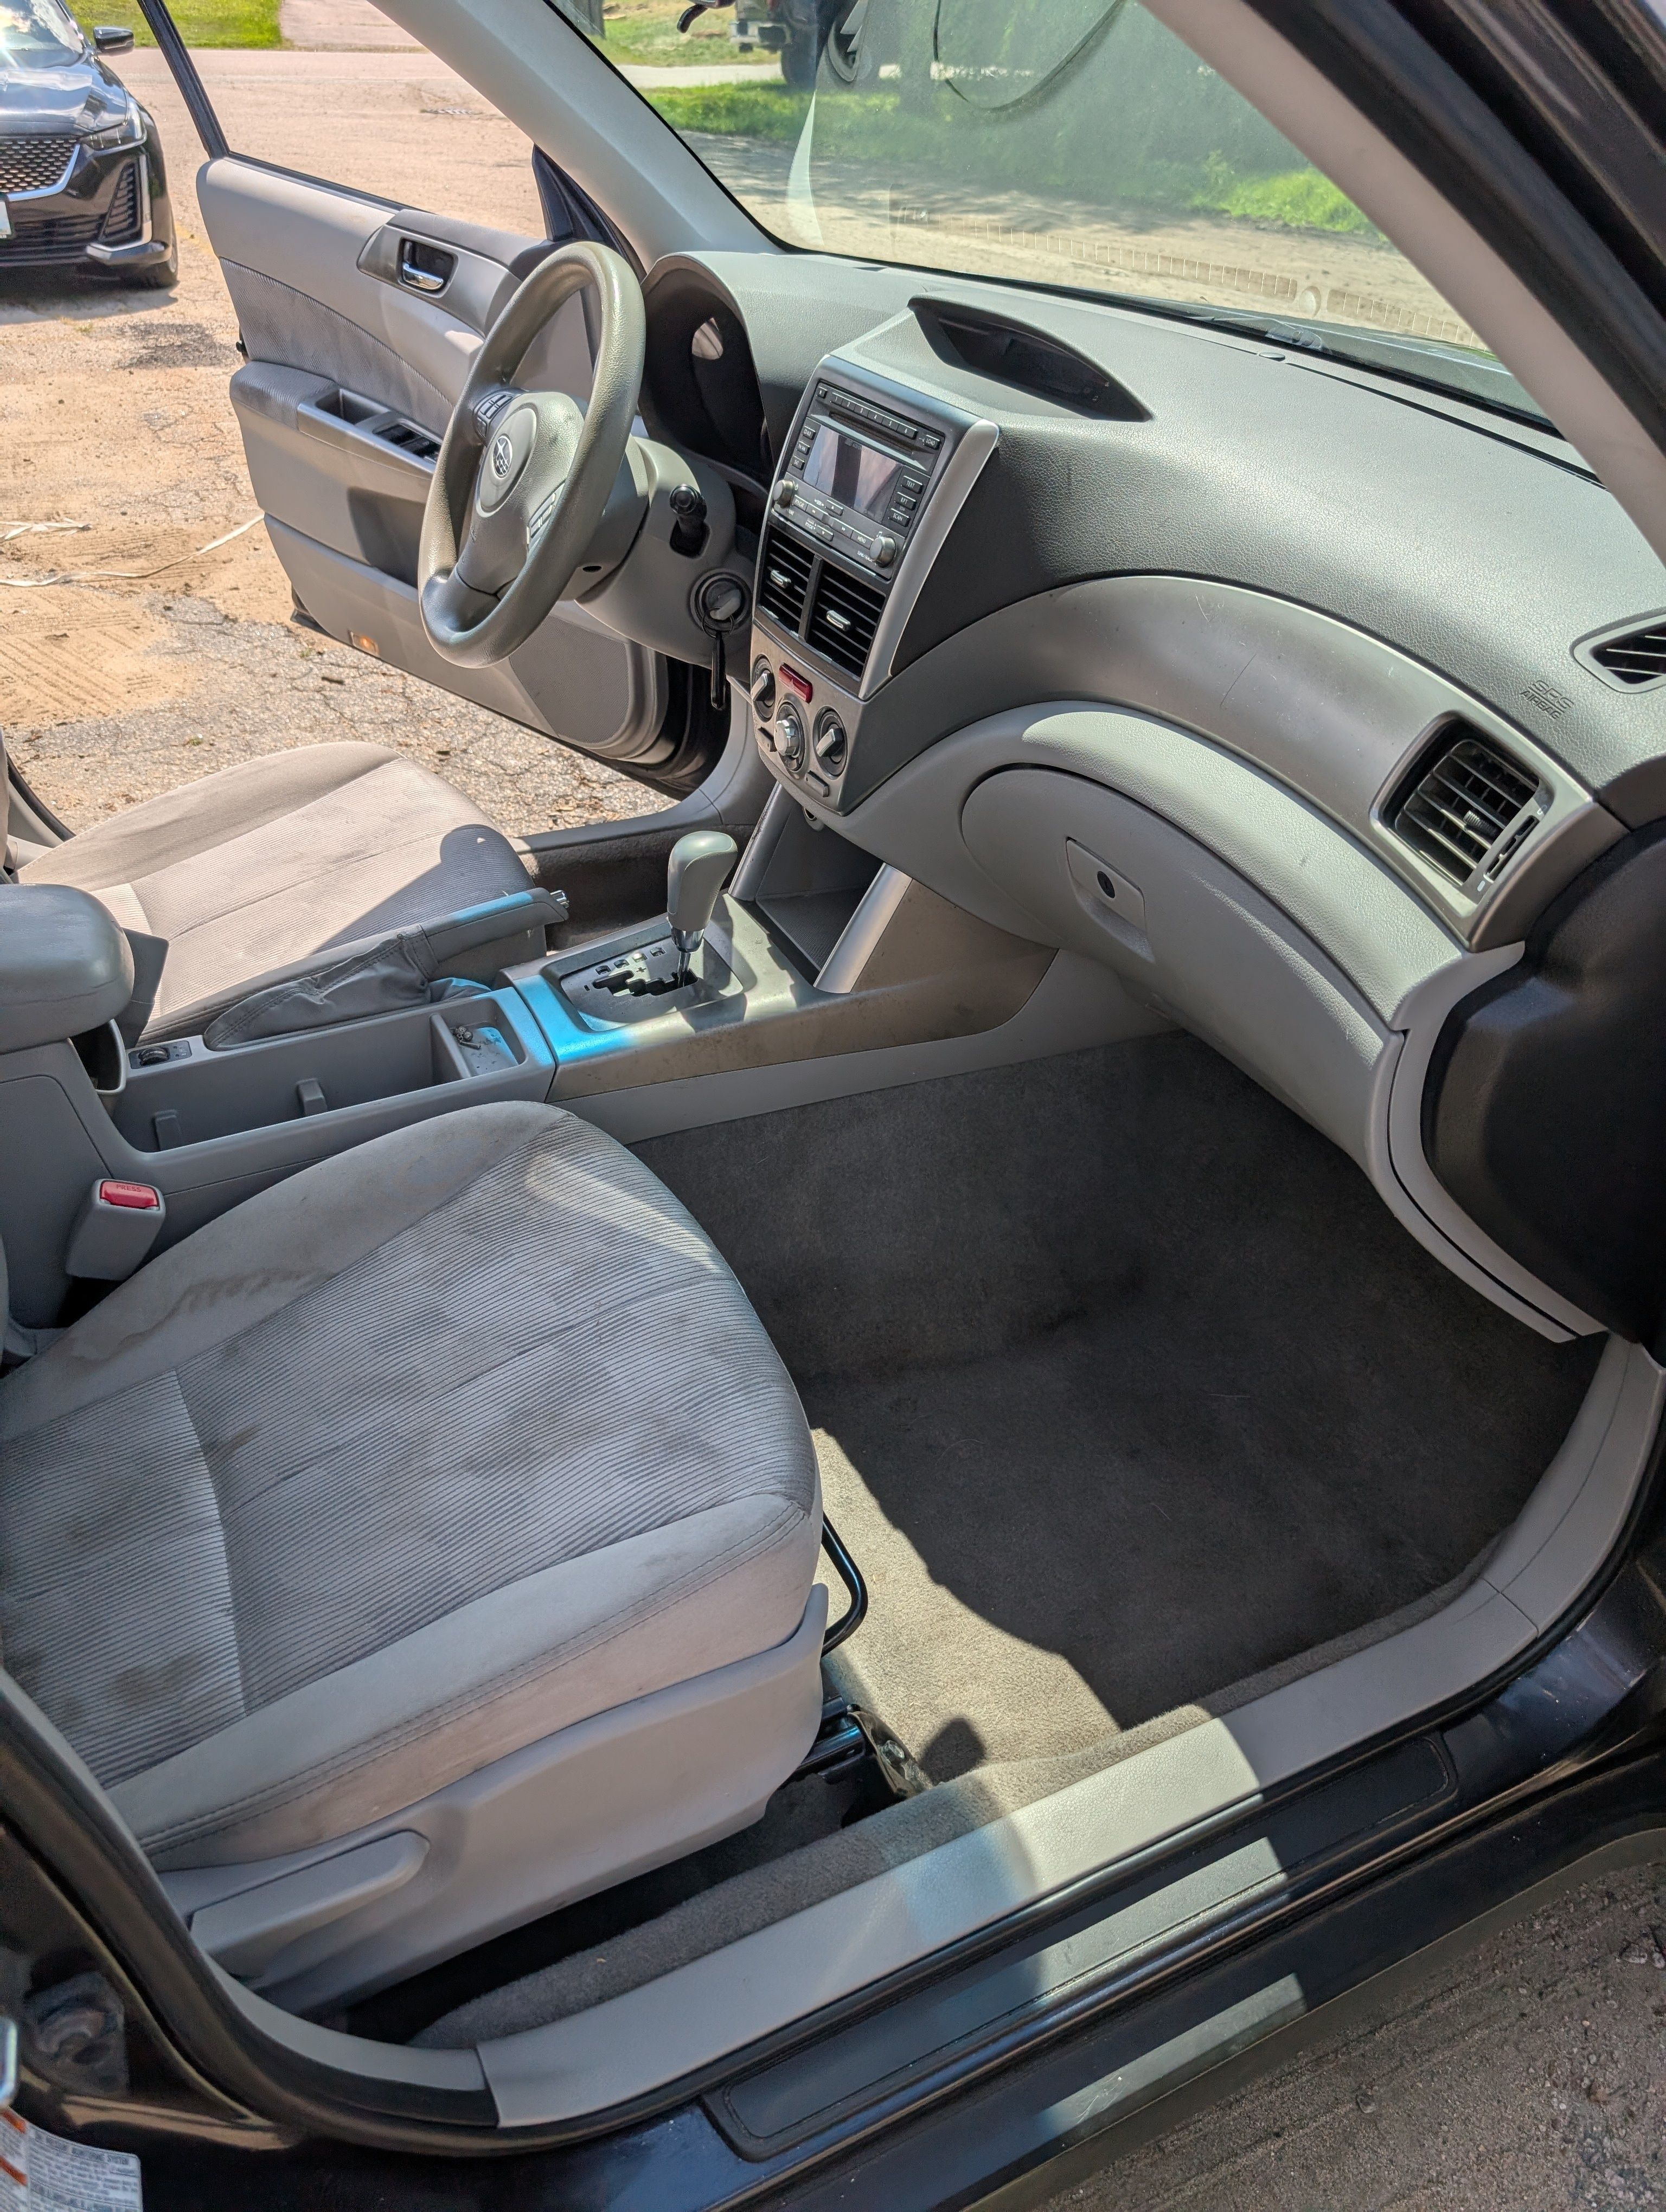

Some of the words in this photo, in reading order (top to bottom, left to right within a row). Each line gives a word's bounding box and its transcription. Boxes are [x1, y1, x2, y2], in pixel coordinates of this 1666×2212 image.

[907, 480, 915, 488] TEXT
[893, 512, 903, 522] SCAN
[857, 536, 867, 544] MENU
[1519, 690, 1562, 719] AIRBAG
[116, 1184, 142, 1192] PRESS
